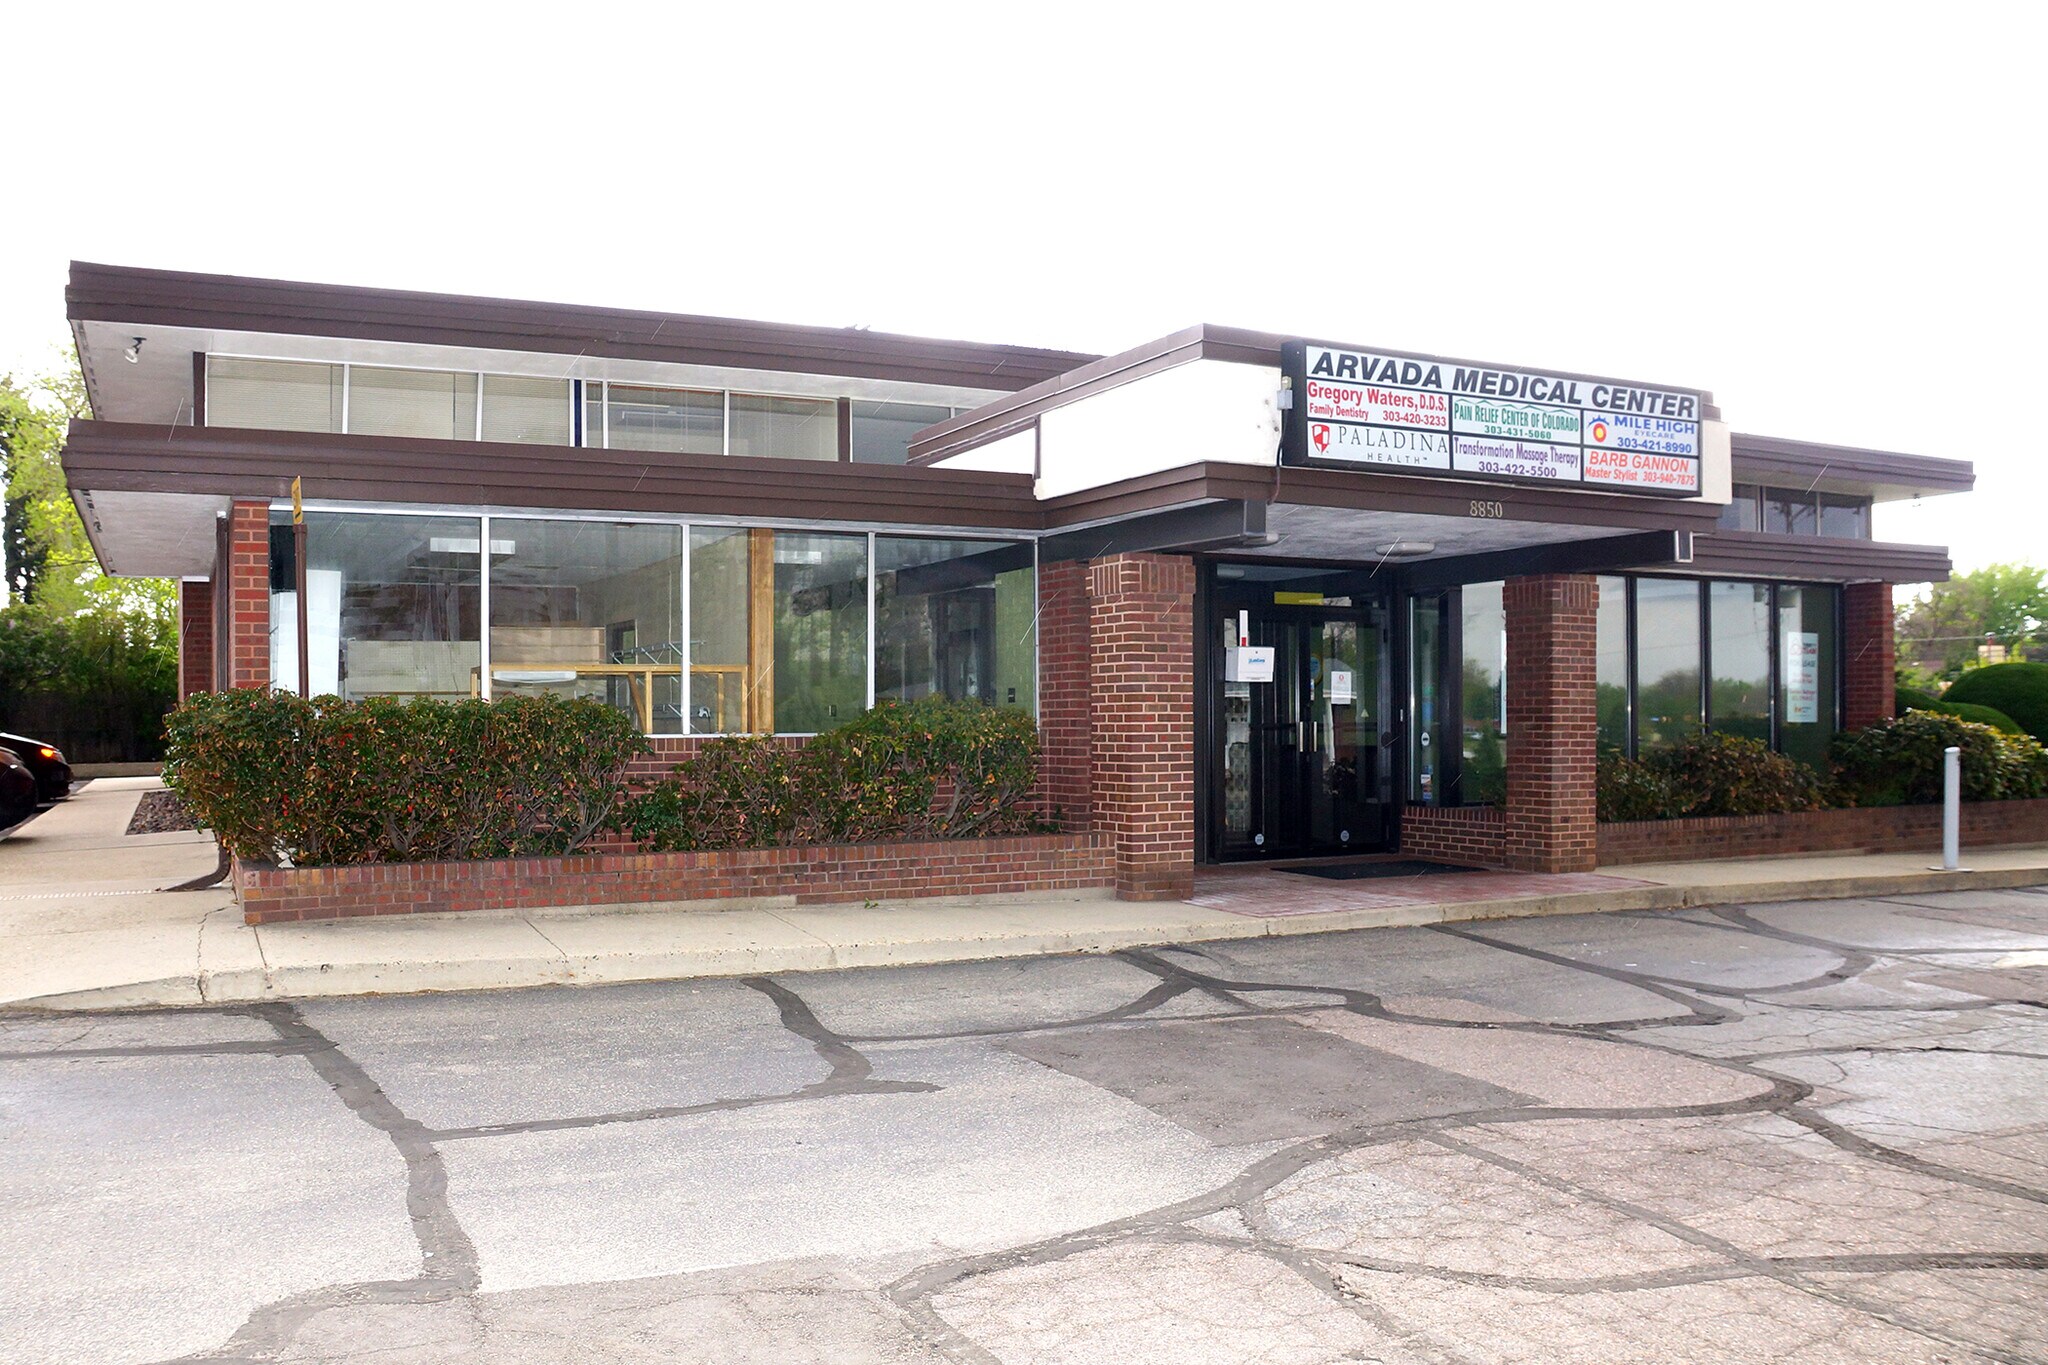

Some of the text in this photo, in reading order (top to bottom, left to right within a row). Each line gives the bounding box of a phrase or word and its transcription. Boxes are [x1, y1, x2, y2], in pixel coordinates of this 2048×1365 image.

[1312, 352, 1694, 418] ARVADA MEDICAL CENTER
[1308, 382, 1446, 412] Gregory Waters, D.D.S.
[1310, 403, 1446, 427] Family Dentistry 303-420-3233
[1454, 403, 1579, 432] PAIN RELIEF CENTER OF COLORADO
[1614, 416, 1694, 434] MILE HIGH
[1338, 426, 1448, 453] PALADINA
[1484, 425, 1552, 440] 303-431-5060
[1634, 430, 1674, 440] EYECARE
[1454, 436, 1578, 468] Transformation Massage Therapy
[1618, 437, 1692, 454] 303-421-8990
[1368, 453, 1420, 464] HEALTH
[1590, 450, 1690, 472] BARB GANNON
[1478, 461, 1557, 478] 303-422-5500
[1585, 466, 1695, 486] Master Stylist 303-940-7875
[1470, 500, 1502, 518] 8850
